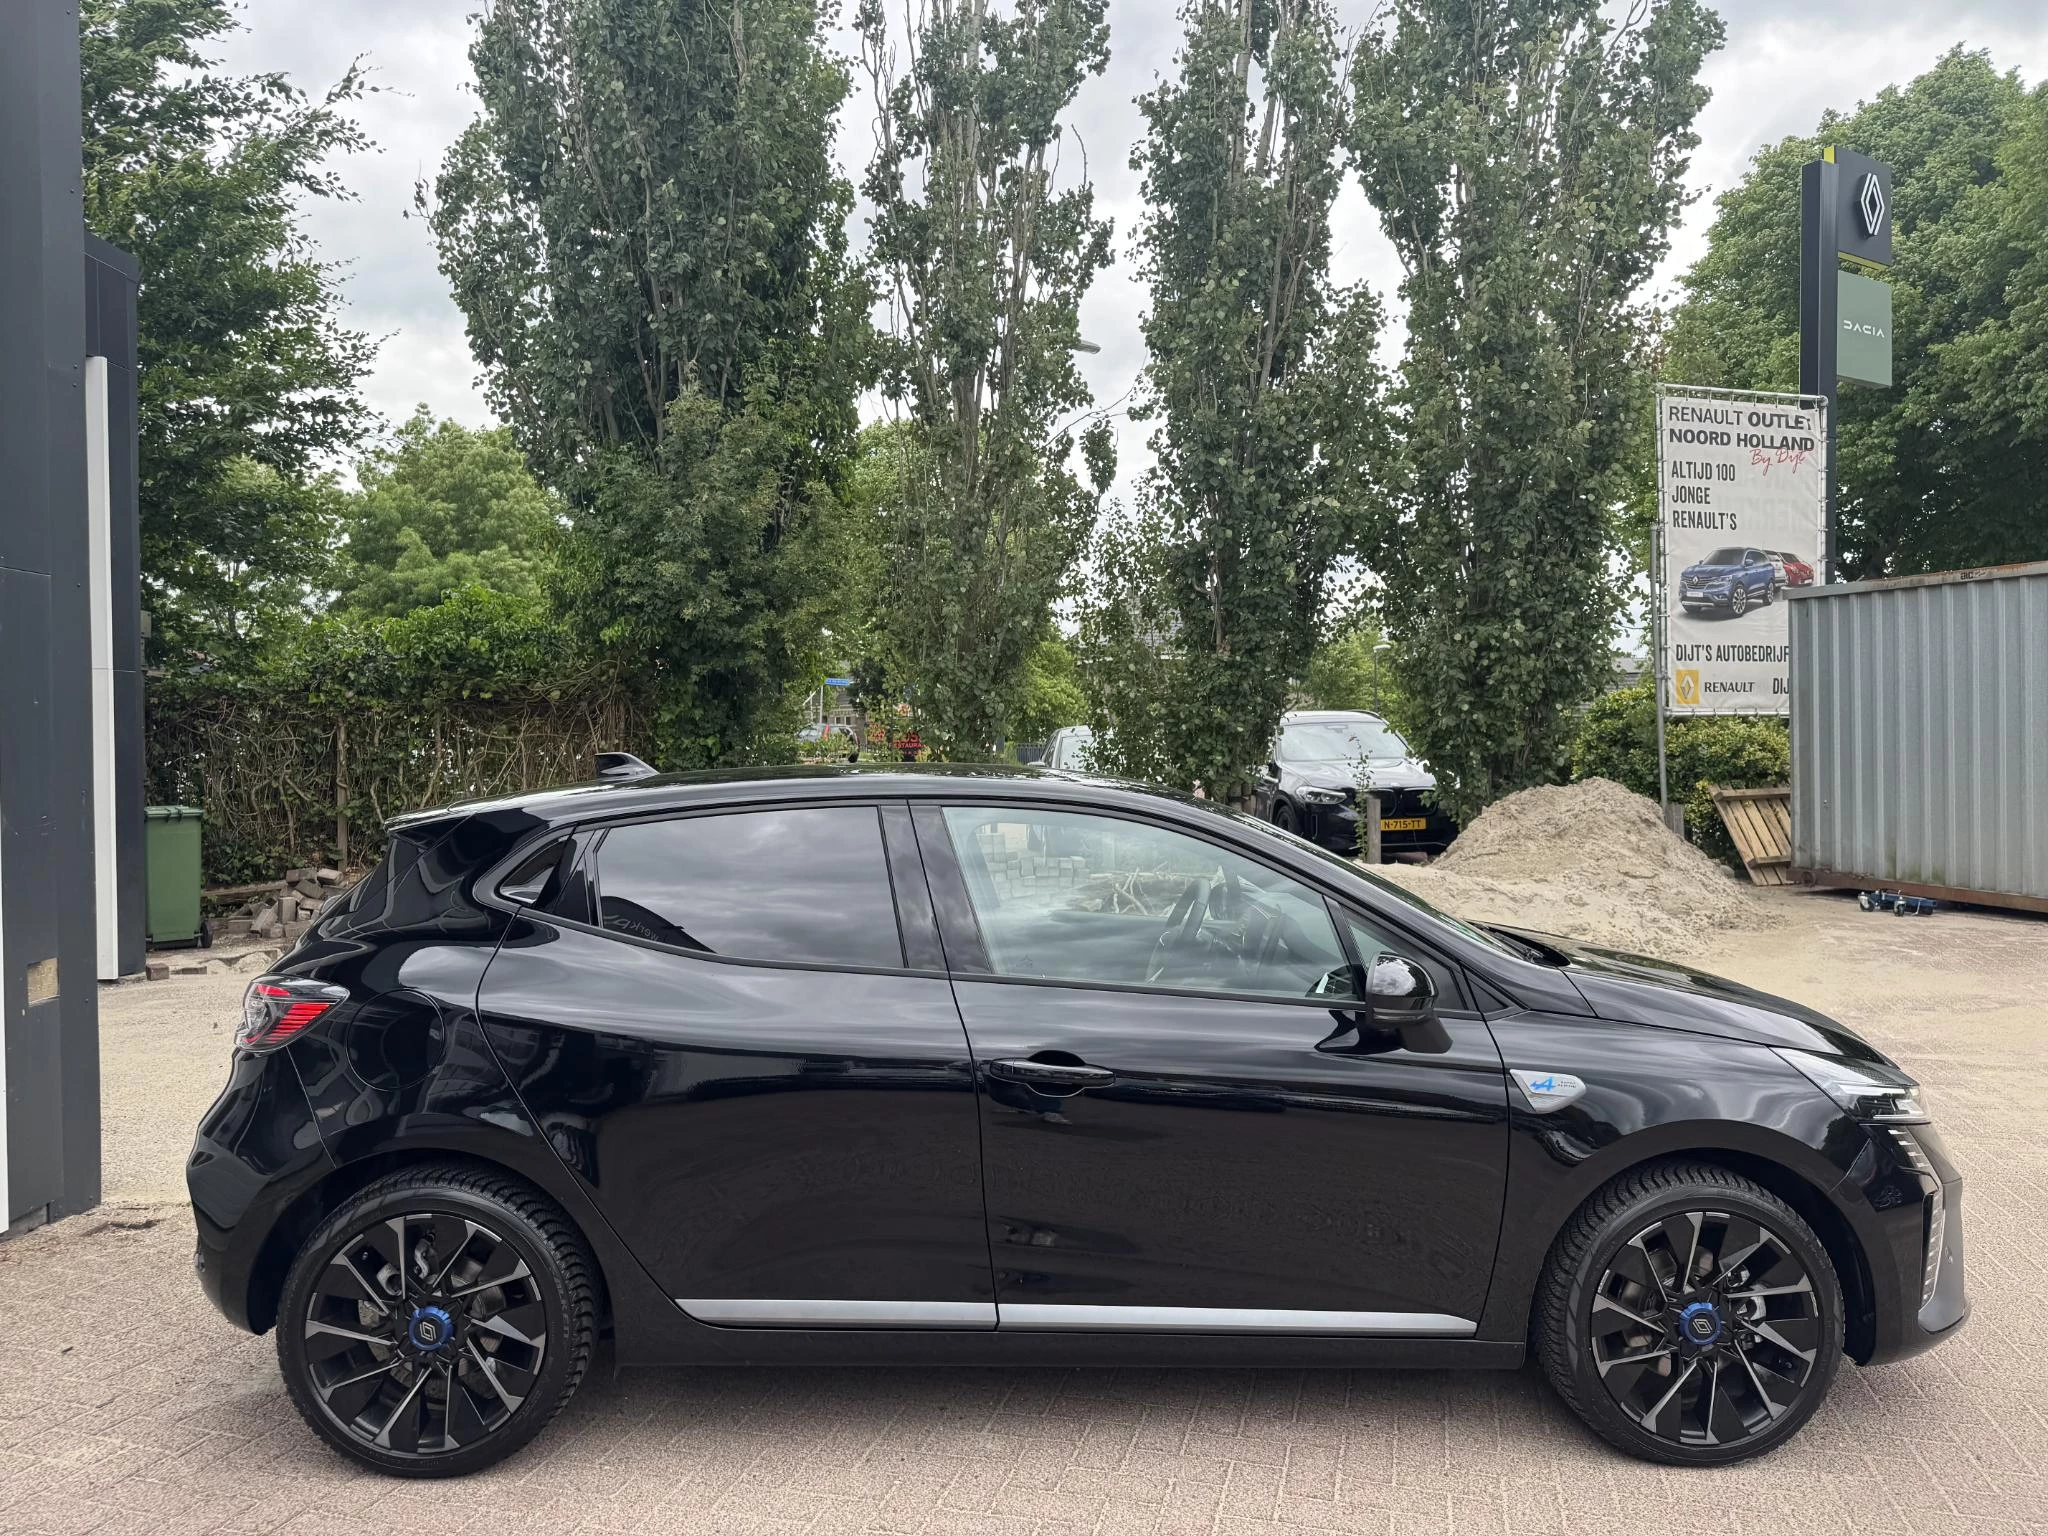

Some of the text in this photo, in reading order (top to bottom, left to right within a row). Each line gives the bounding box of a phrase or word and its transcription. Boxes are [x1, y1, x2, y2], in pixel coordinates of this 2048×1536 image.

[1843, 319, 1885, 338] DACIA
[1669, 406, 1743, 425] RENAULT
[1669, 428, 1815, 451] NOORD HOLLAND
[1671, 460, 1735, 481] ALTIJD 100
[1671, 485, 1711, 504] JONGE
[1672, 510, 1737, 530] RENAULT'S
[1676, 644, 1712, 661] DIJT'S
[1704, 677, 1789, 694] RENAULT DIJ
[1384, 820, 1421, 829] N-715-TT
